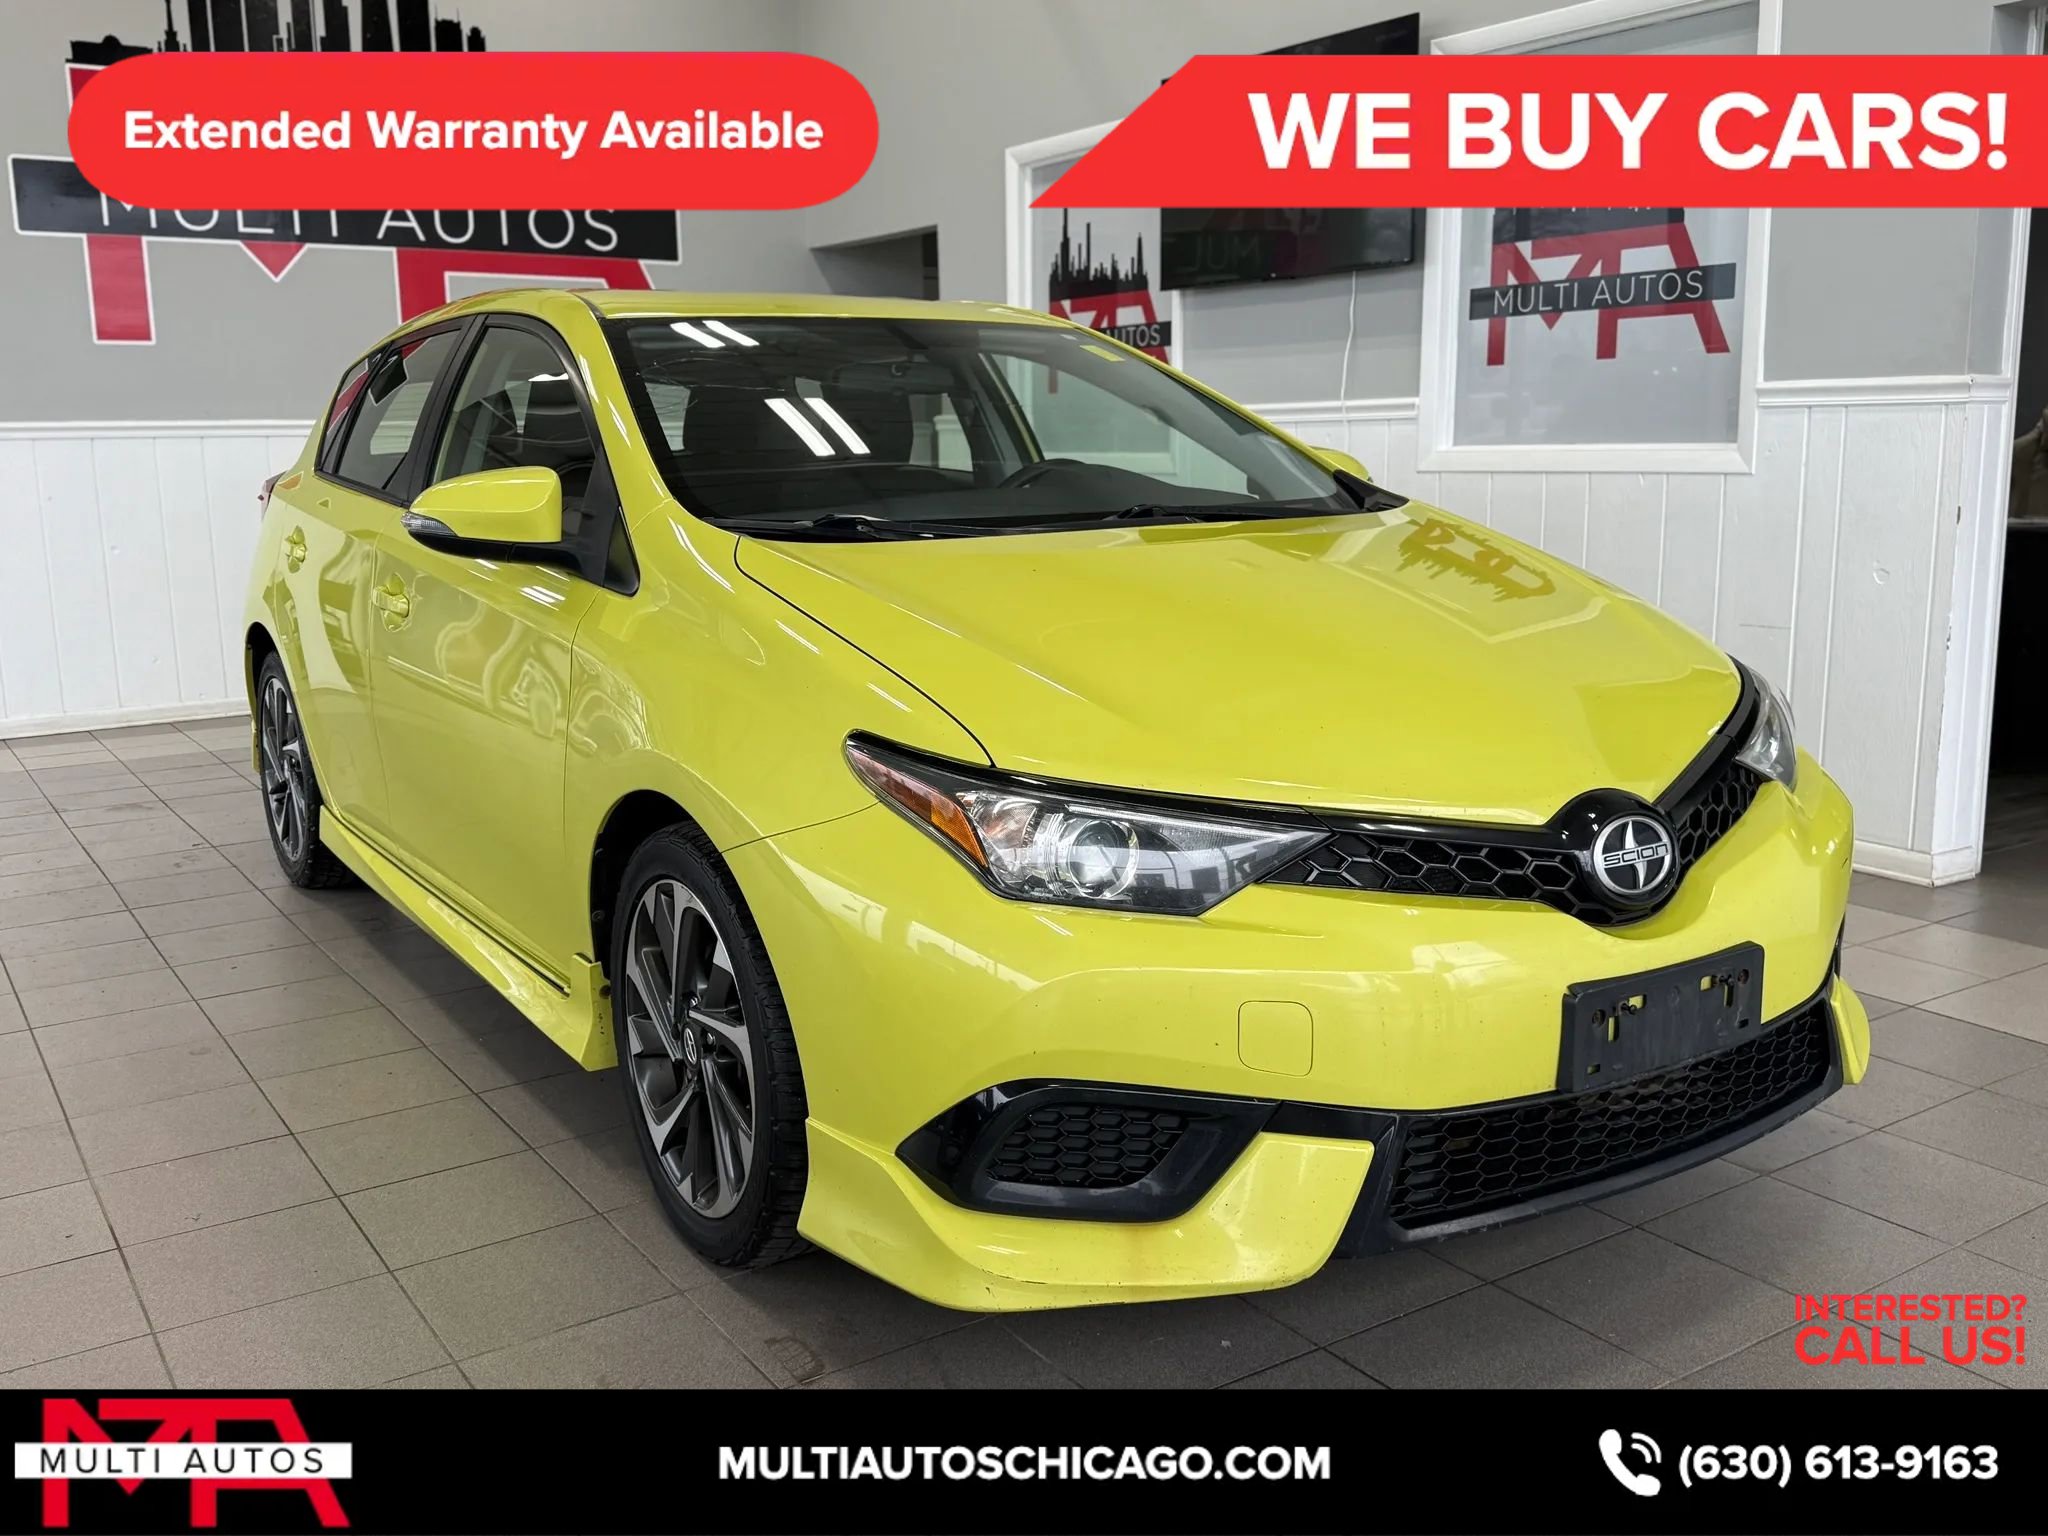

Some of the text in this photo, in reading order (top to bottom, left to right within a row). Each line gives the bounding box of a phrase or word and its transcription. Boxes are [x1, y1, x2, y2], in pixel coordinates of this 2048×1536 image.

[1493, 270, 1704, 315] MULTI AUTOS
[1106, 324, 1161, 347] UTOS
